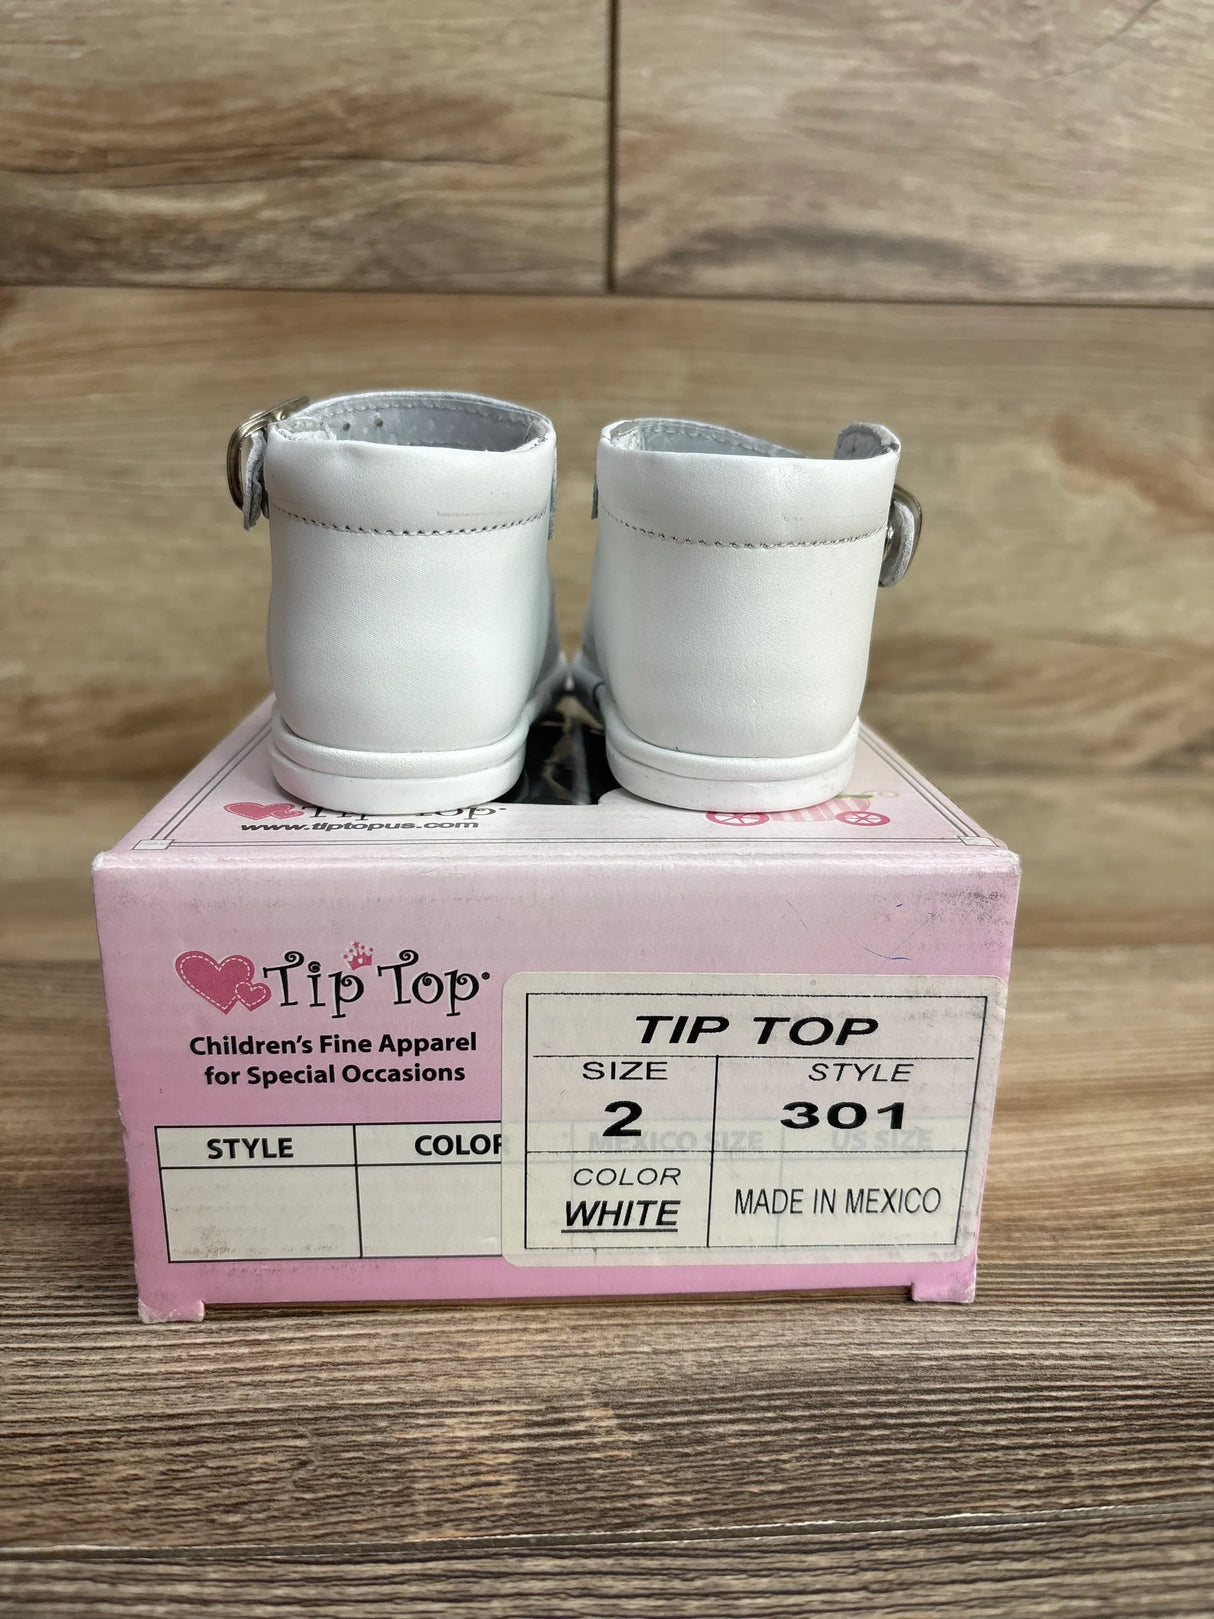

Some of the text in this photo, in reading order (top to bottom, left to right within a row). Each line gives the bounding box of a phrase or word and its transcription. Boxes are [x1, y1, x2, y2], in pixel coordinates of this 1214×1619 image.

[240, 820, 479, 833] www.tiptopus.com
[262, 950, 365, 1019] Tip
[189, 1031, 478, 1058] Children's Fine Apparel
[635, 1015, 880, 1047] TIP TOP
[204, 1062, 467, 1090] for Special Occasions
[581, 1061, 669, 1082] SIZE
[807, 1062, 915, 1083] STYLE
[602, 1100, 643, 1138] 2
[779, 1101, 906, 1131] 301
[206, 1137, 295, 1161] STYLE
[572, 1167, 682, 1187] COLOR
[564, 1199, 681, 1228] WHITE
[734, 1186, 942, 1216] MADE IN MEXICO
